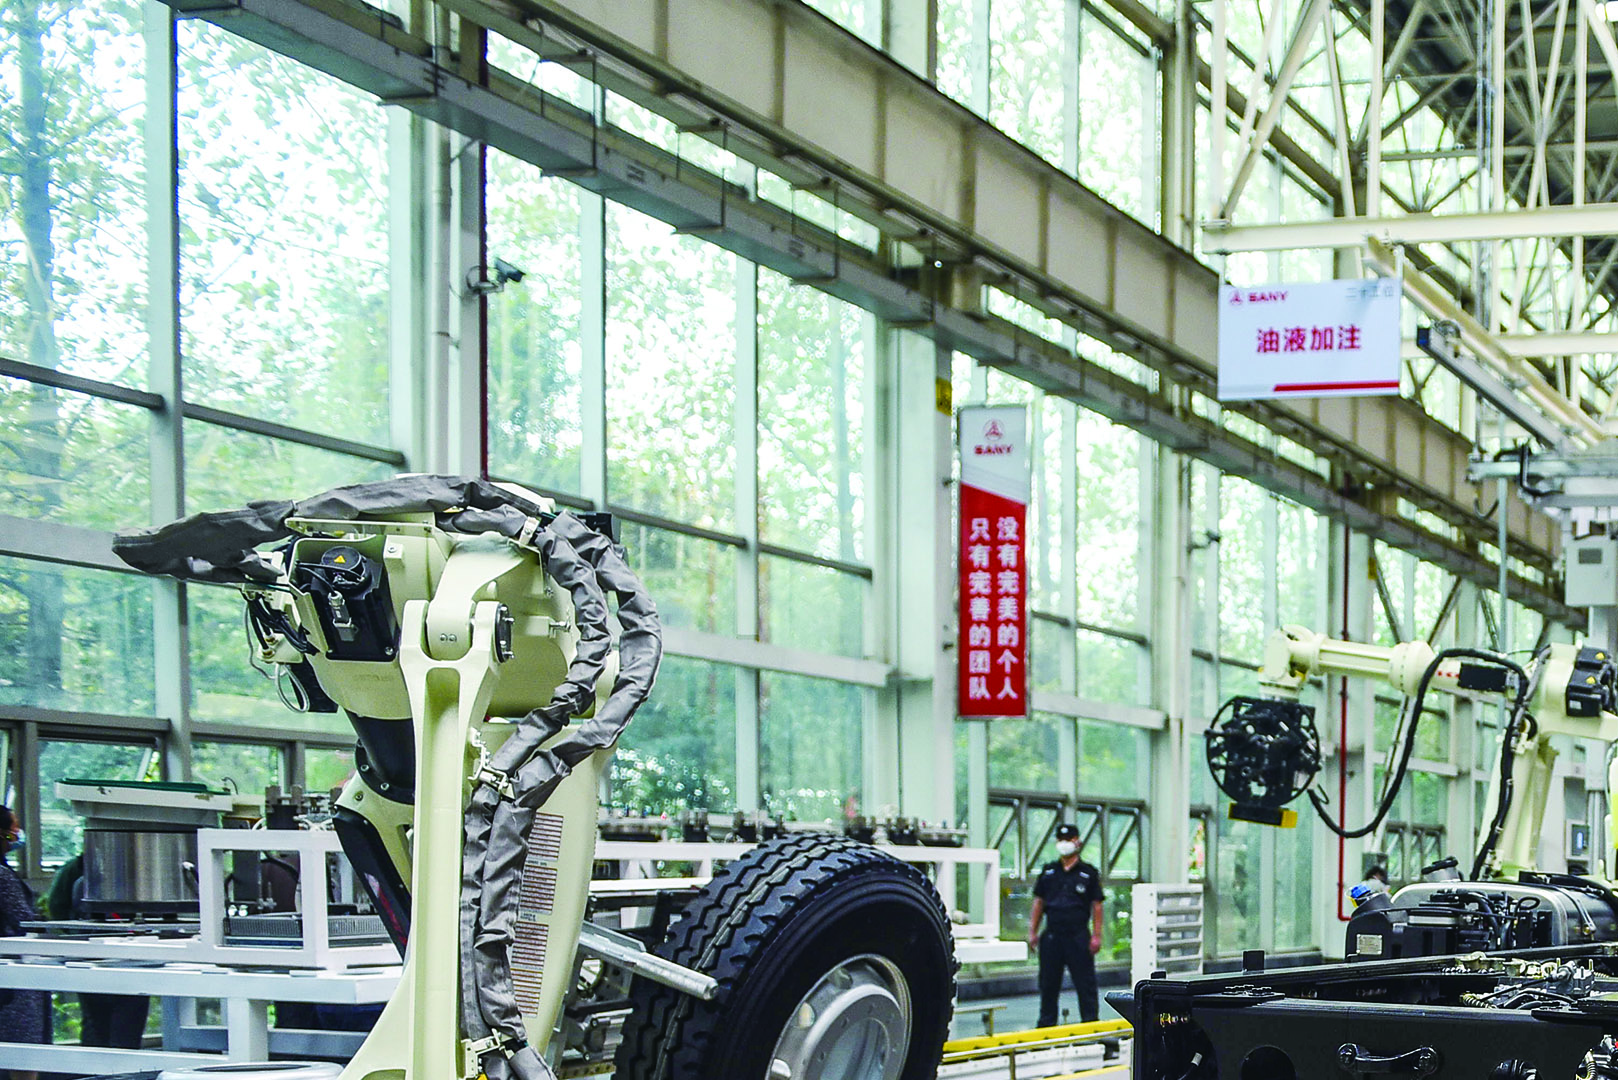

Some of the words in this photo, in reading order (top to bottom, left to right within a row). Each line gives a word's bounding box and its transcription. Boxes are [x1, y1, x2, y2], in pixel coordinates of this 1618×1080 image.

[1248, 291, 1288, 302] SANY
[1257, 324, 1361, 353] 油液加注
[974, 444, 1012, 455] SANY
[968, 517, 992, 700] 只有完善的团队
[996, 516, 1020, 700] 没有完美的个人
